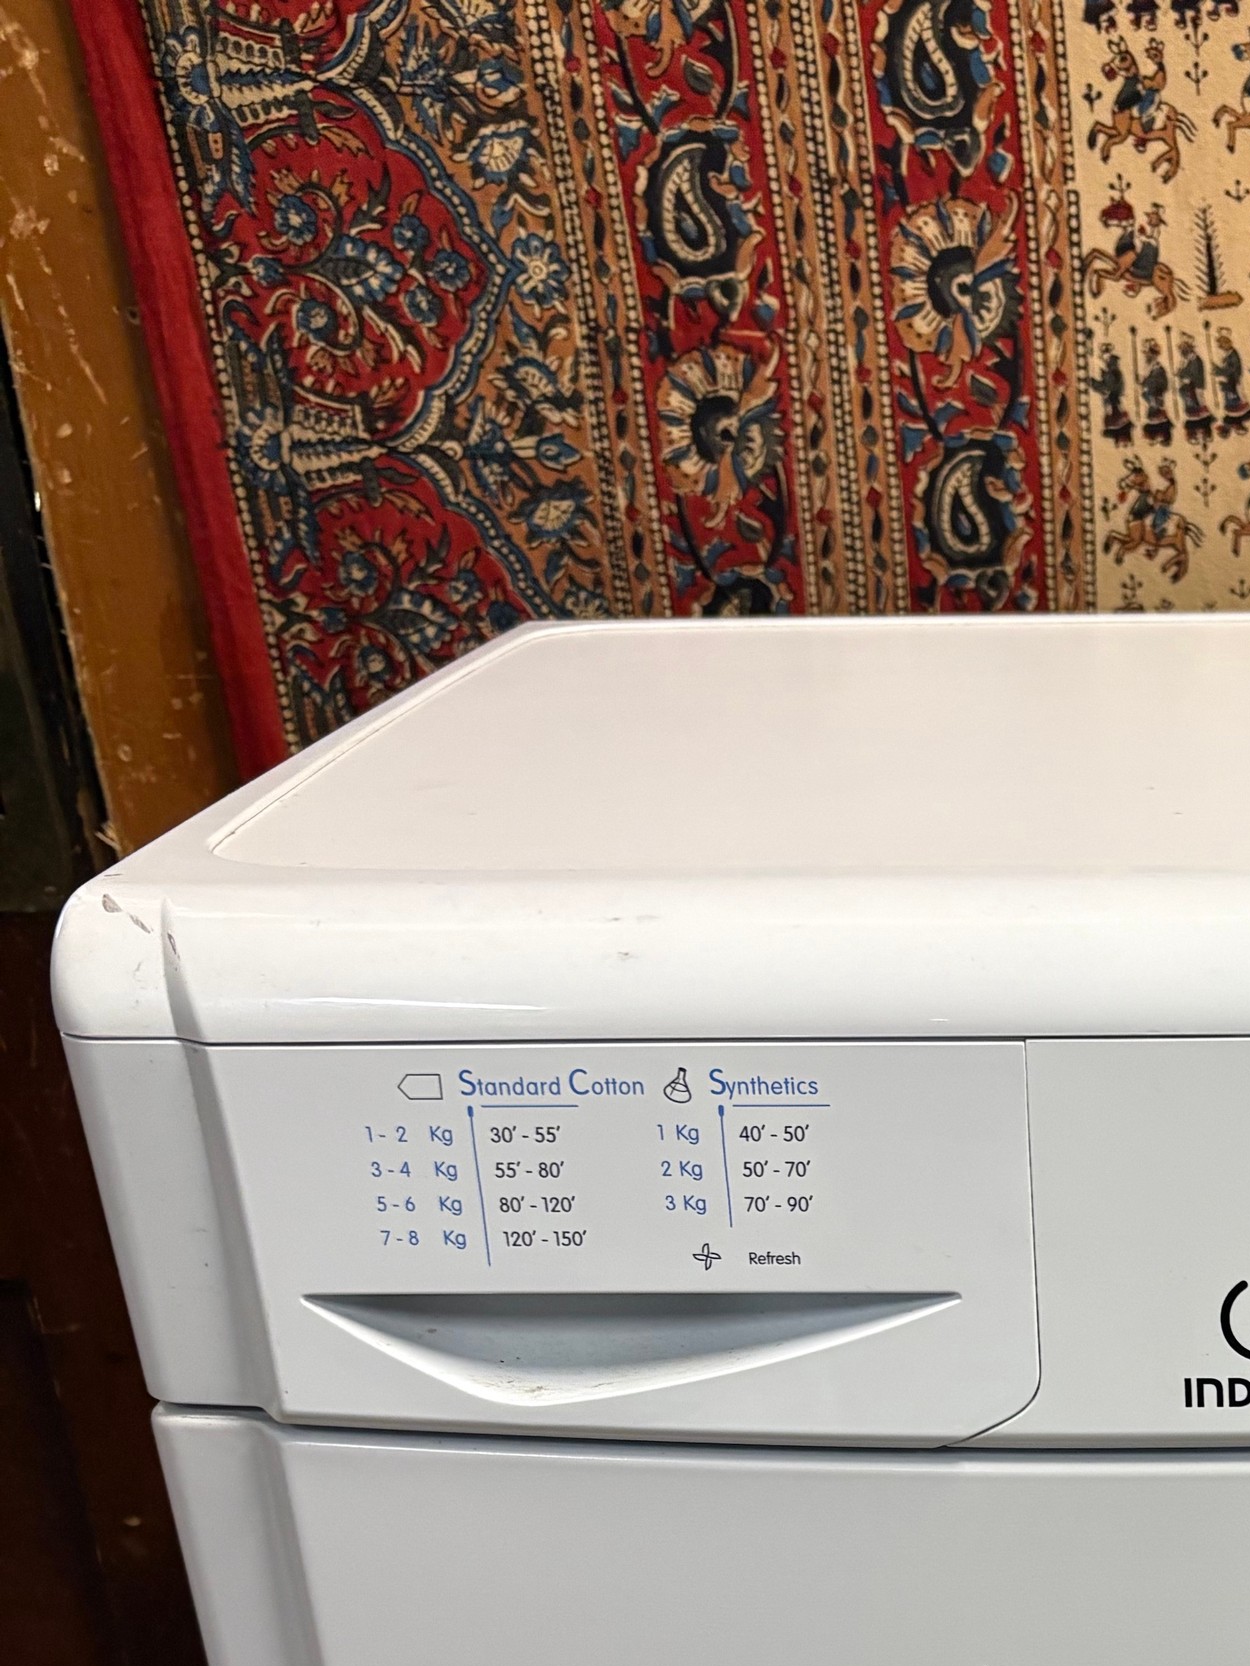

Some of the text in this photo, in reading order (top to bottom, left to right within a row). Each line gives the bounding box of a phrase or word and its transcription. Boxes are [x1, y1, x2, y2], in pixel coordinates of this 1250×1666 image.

[458, 1068, 645, 1097] Standard Cotton
[709, 1068, 819, 1101] Synthetics
[429, 1126, 454, 1147] Kg
[676, 1124, 700, 1146] Kg
[434, 1161, 459, 1182] Kg
[679, 1161, 704, 1182] Kg
[439, 1196, 463, 1217] Kg
[683, 1195, 707, 1216] Kg
[443, 1230, 467, 1250] Kg
[749, 1251, 802, 1266] Refresh
